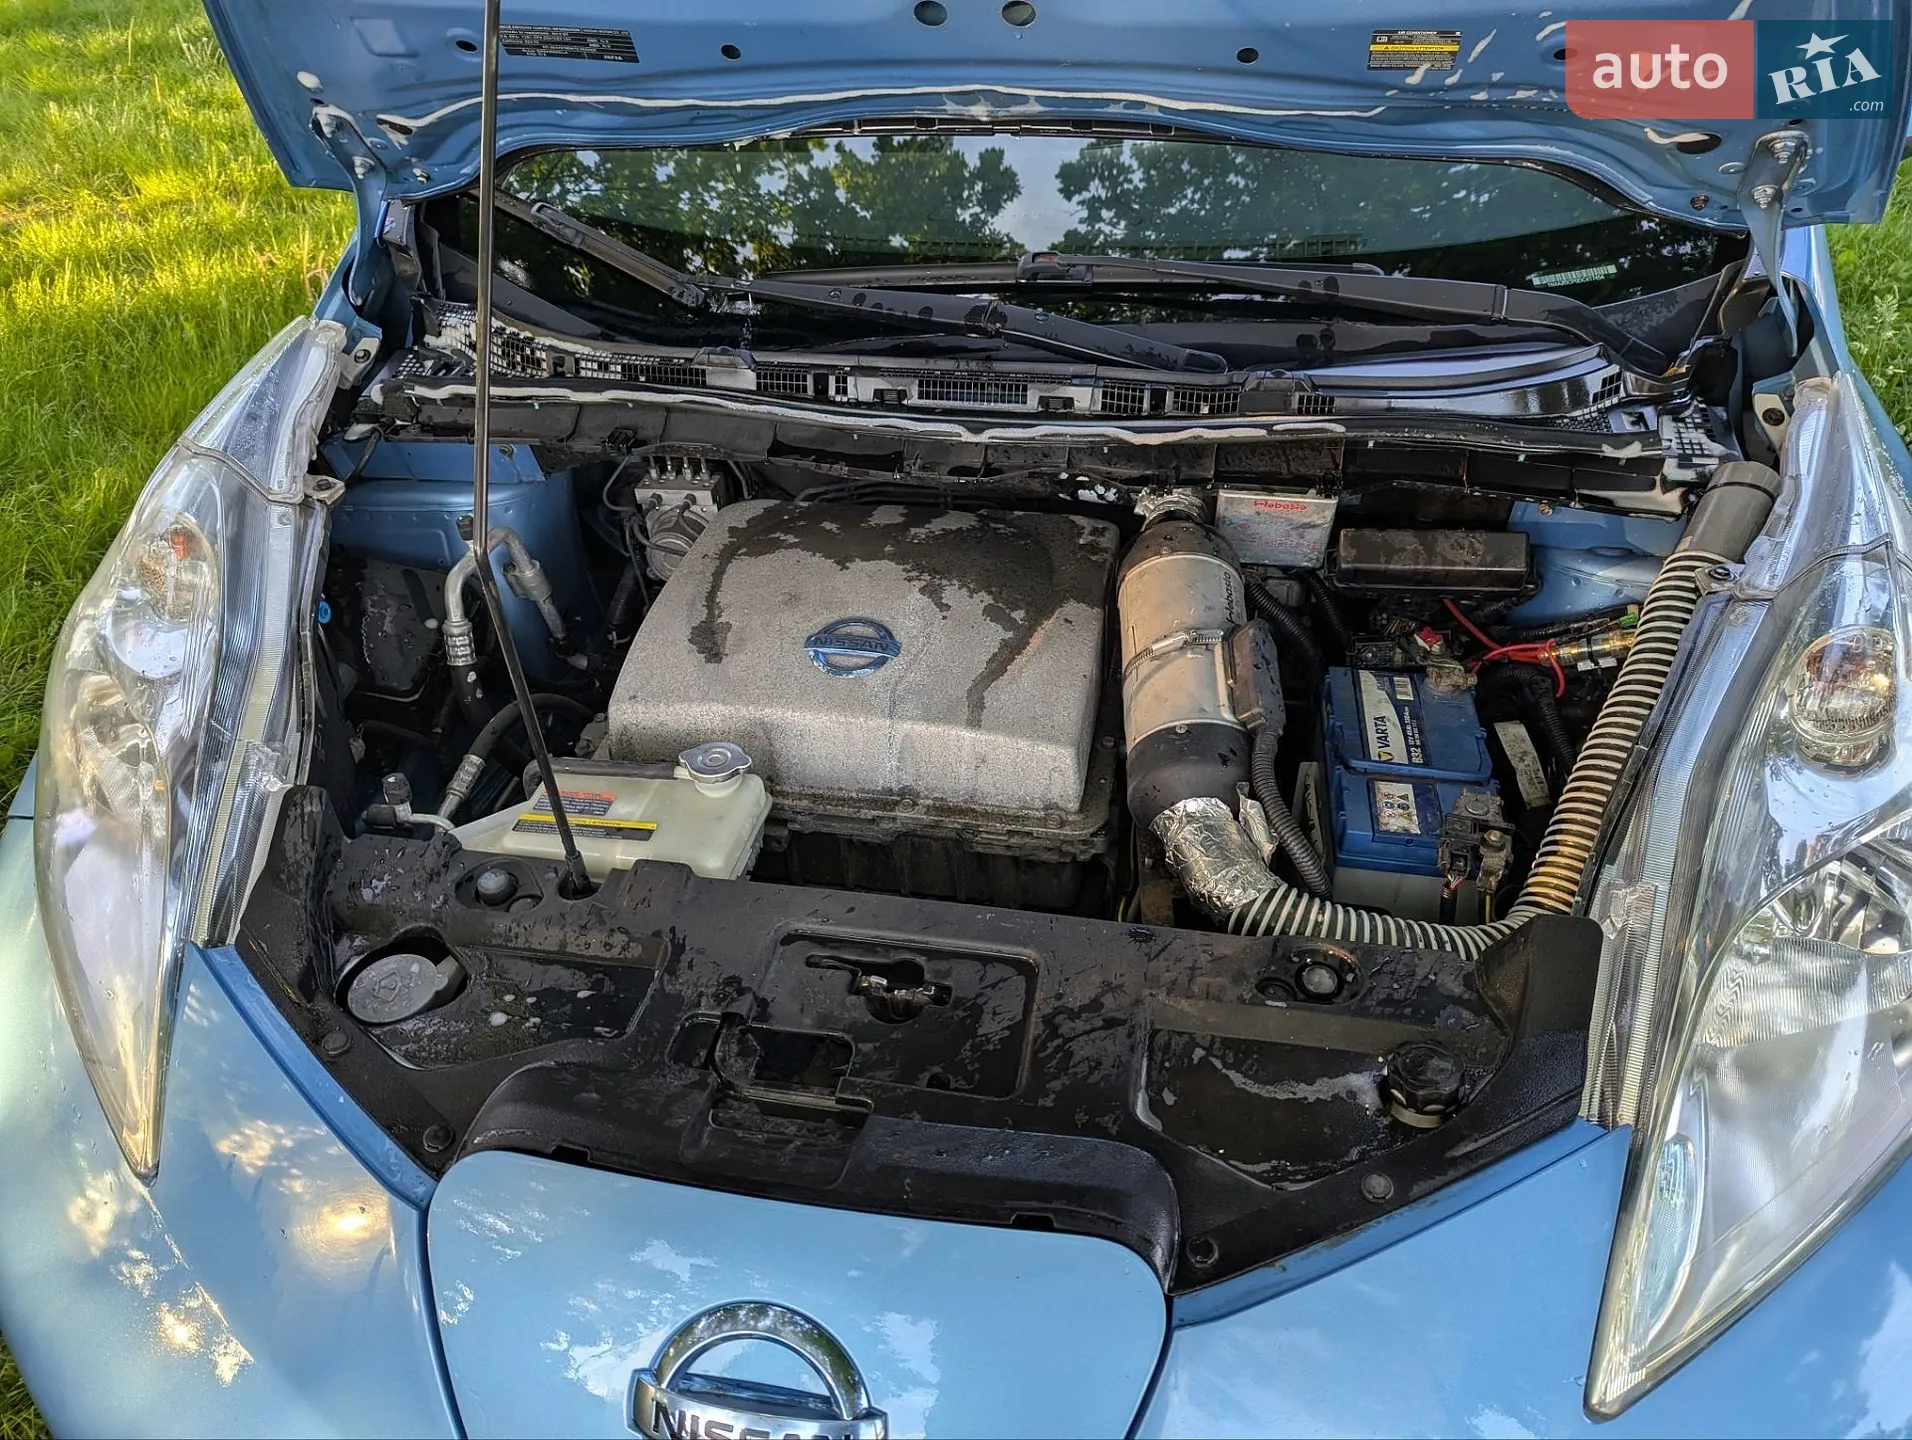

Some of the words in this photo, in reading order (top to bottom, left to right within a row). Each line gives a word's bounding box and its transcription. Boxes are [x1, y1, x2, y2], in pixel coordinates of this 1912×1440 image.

[814, 637, 890, 651] NISSAN
[1374, 715, 1391, 749] VARTA
[1410, 748, 1424, 763] B32
